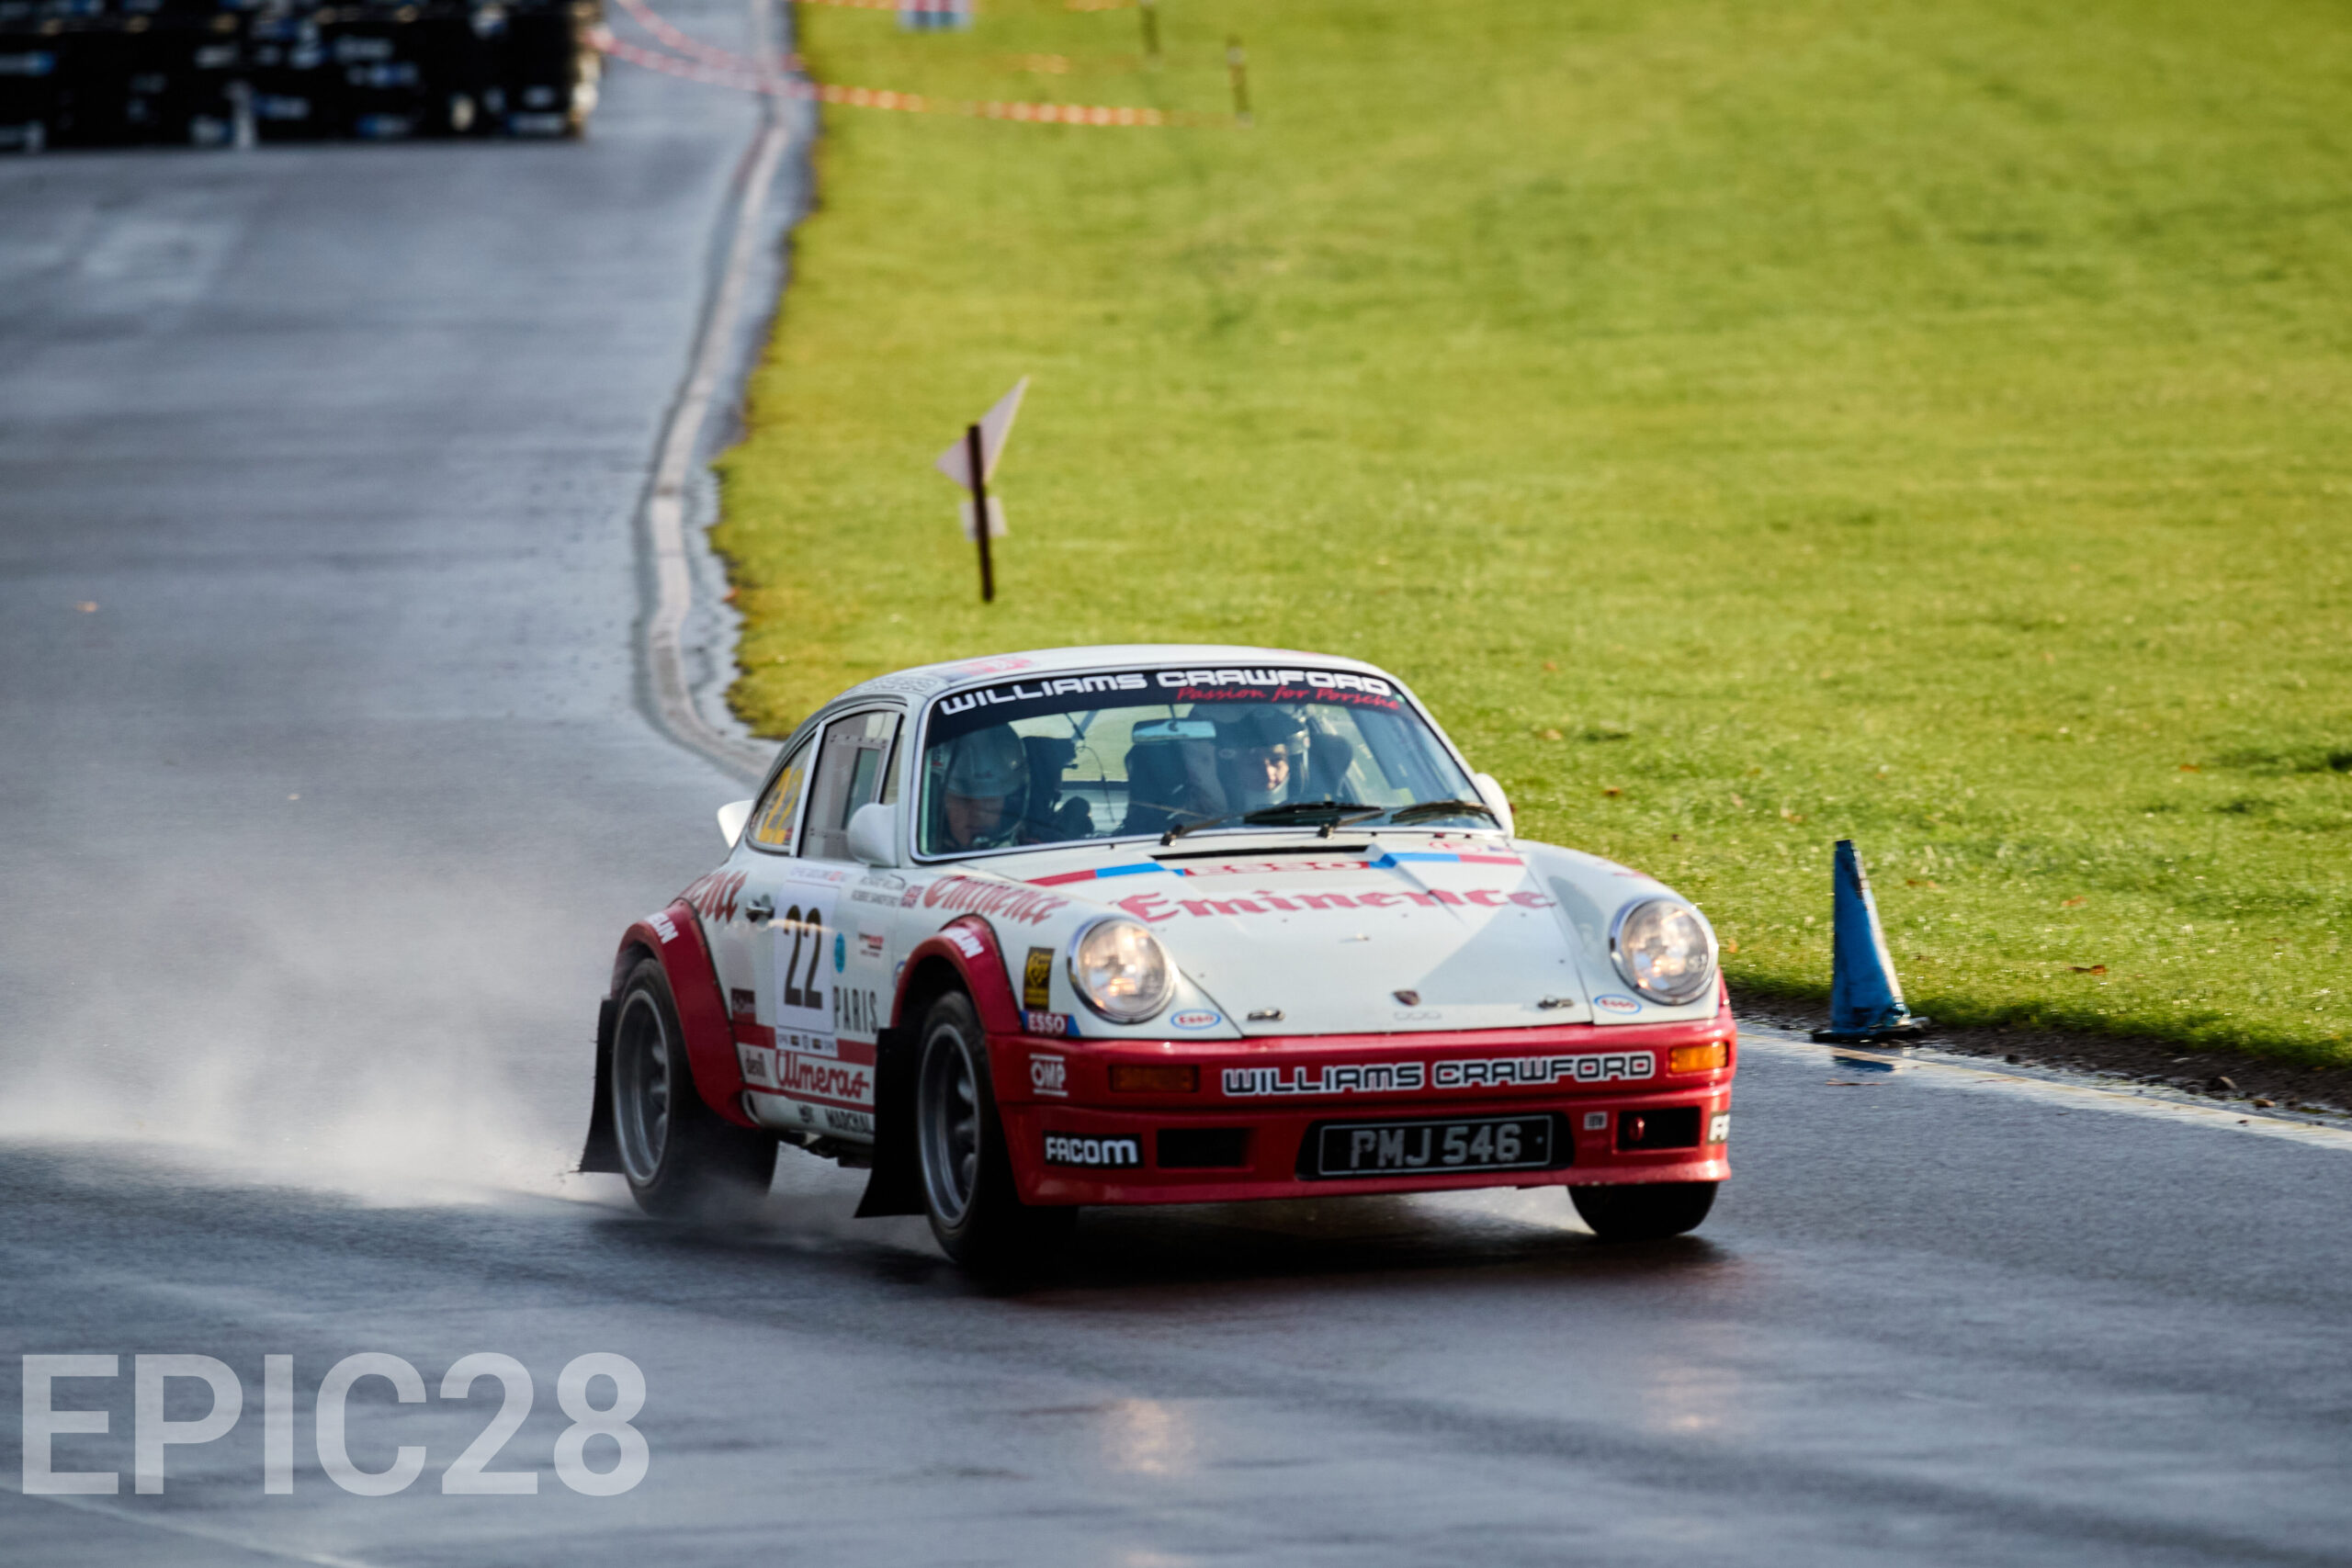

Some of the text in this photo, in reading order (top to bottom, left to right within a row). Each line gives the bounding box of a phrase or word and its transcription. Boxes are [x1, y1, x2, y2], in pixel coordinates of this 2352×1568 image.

[939, 672, 1148, 716] WILLIAMS
[1156, 669, 1392, 696] CRAWFORD
[1176, 685, 1400, 710] Passion for Porsche
[1192, 862, 1363, 876] ESSO
[1108, 888, 1556, 923] Eminence
[783, 904, 824, 1010] 22
[833, 986, 879, 1035] PARIS
[1028, 1013, 1066, 1032] ESSO
[1030, 1061, 1066, 1089] OMP
[1222, 1051, 1655, 1097] WILLIAMS CRAWFORD
[1351, 1122, 1521, 1169] PMJ 546
